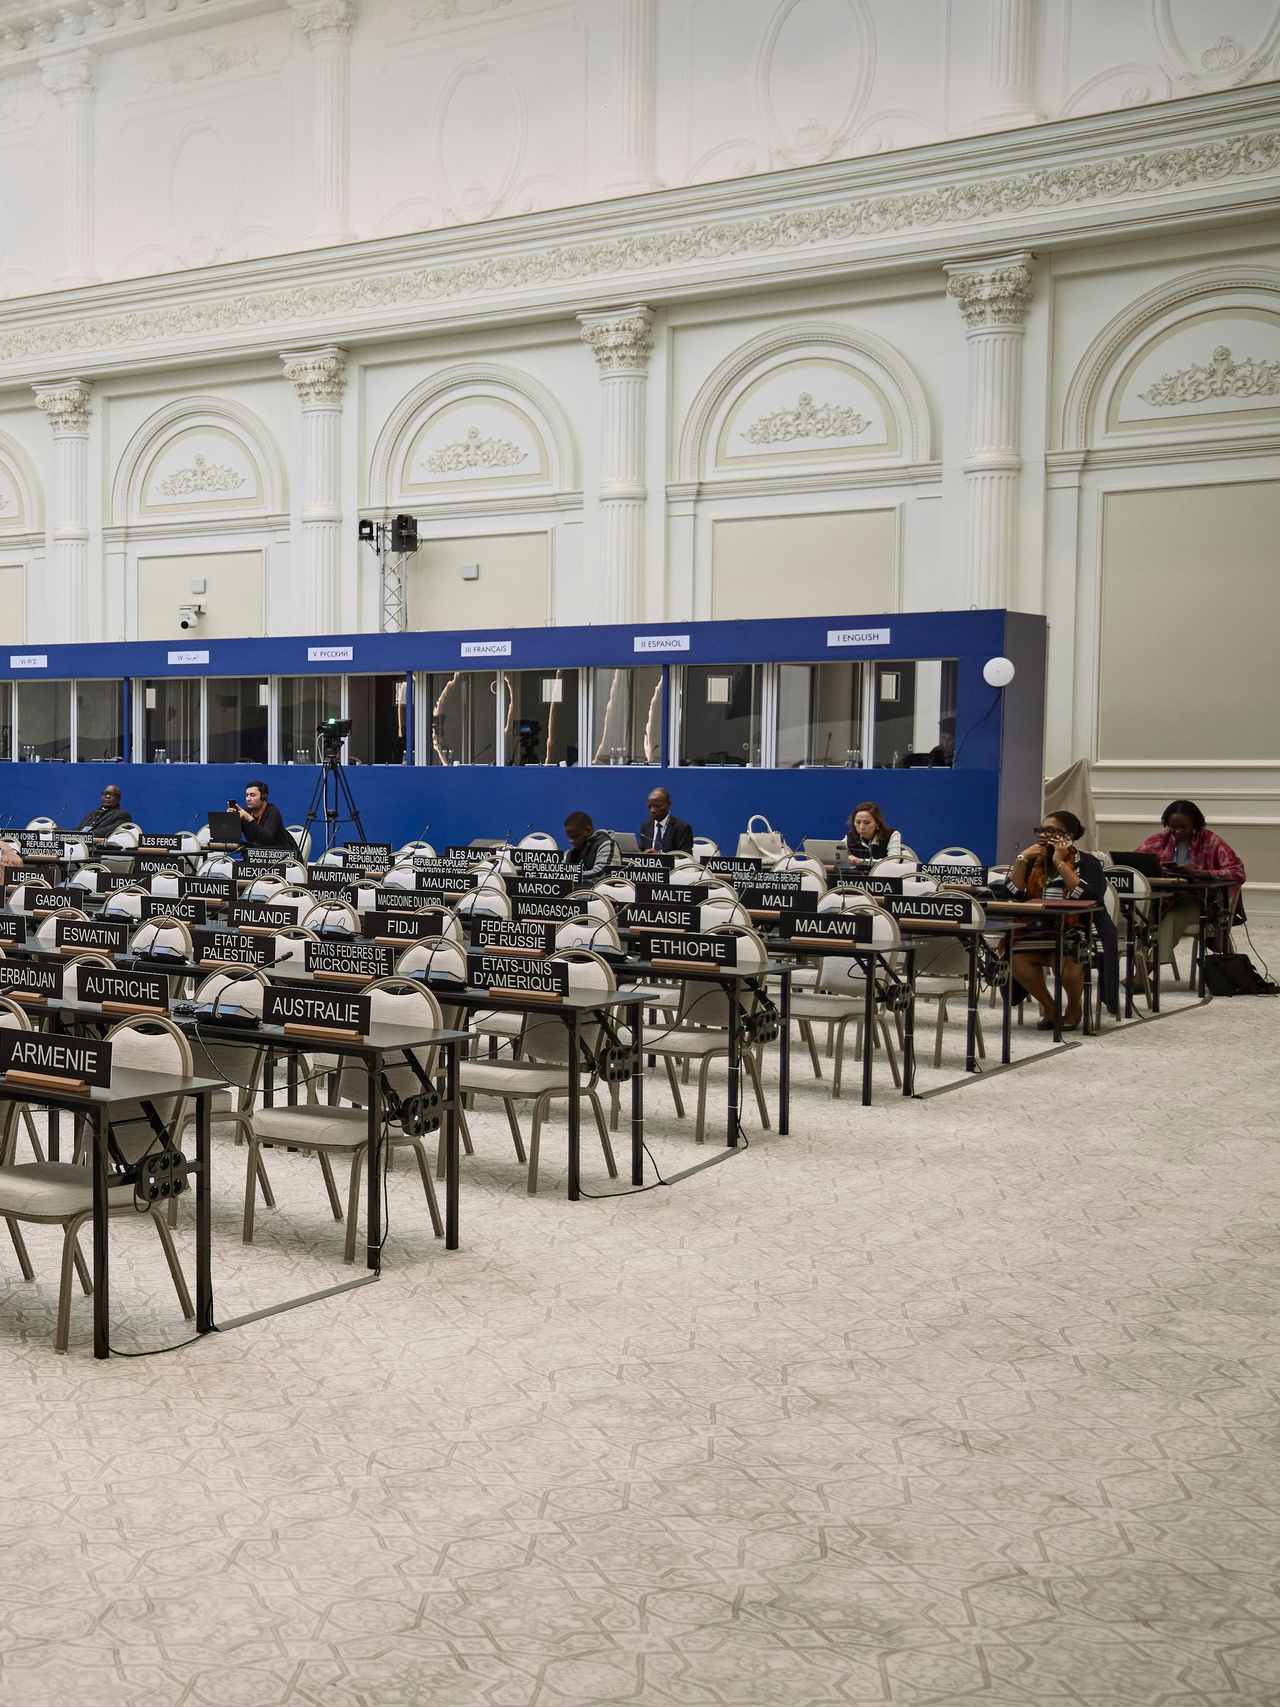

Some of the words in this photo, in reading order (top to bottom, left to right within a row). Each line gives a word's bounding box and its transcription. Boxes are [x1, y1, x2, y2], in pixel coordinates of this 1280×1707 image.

[648, 639, 682, 648] ESPAÑOL
[843, 633, 879, 642] ENGLISH
[320, 649, 348, 658] РУССКИЙ
[474, 645, 506, 654] FRANÇAIS
[26, 840, 59, 848] REPUBLIQUE
[141, 835, 156, 846] ÎLES
[156, 836, 178, 846] FEROE
[348, 853, 389, 864] REPUBLIQUE
[414, 857, 442, 866] REPUBLIQUE
[442, 858, 469, 867] POPULAIRE
[706, 860, 756, 872] ANGUILLA
[140, 861, 179, 872] MONACO
[237, 866, 280, 878] MEXIQUE
[523, 863, 582, 873] REPUBLIQUE-UNIE
[12, 871, 45, 882] LIBERIA
[312, 870, 360, 883] MAURITANIE
[422, 877, 471, 890] MAURICE
[611, 870, 665, 883] ROUMANIE
[185, 881, 230, 896] LITUANIE
[517, 882, 561, 896] MAROC
[836, 879, 894, 894] RWANDA
[35, 892, 72, 907] GABON
[650, 888, 692, 903] MALTE
[761, 893, 794, 908] MALI
[149, 902, 195, 917] FRANCE
[233, 907, 292, 925] FINLANDE
[517, 901, 581, 917] MADAGASCAR
[891, 900, 965, 917] MALDIVES
[626, 908, 691, 925] MALAISIE
[386, 919, 419, 935] FIDJI
[480, 919, 546, 936] FEDERATION
[794, 918, 856, 935] MALAWI
[62, 926, 120, 946] ESWATINI
[214, 933, 239, 948] ETAT
[239, 935, 255, 949] DE
[478, 932, 492, 944] DE
[500, 934, 547, 949] RUSSIE
[202, 946, 265, 964] PALESTINE
[311, 941, 335, 956] ETATS
[336, 943, 374, 960] FEDERES
[374, 947, 387, 961] DE
[649, 937, 726, 959] ETHIOPIE
[309, 957, 389, 976] MICRONESIE
[481, 957, 553, 976] ETATS-UNIS
[84, 975, 161, 1001] AUTRICHE
[473, 971, 563, 992] D'AMERIQUE
[271, 995, 361, 1024] AUSTRALIE
[9, 1040, 99, 1074] ARMENIE
